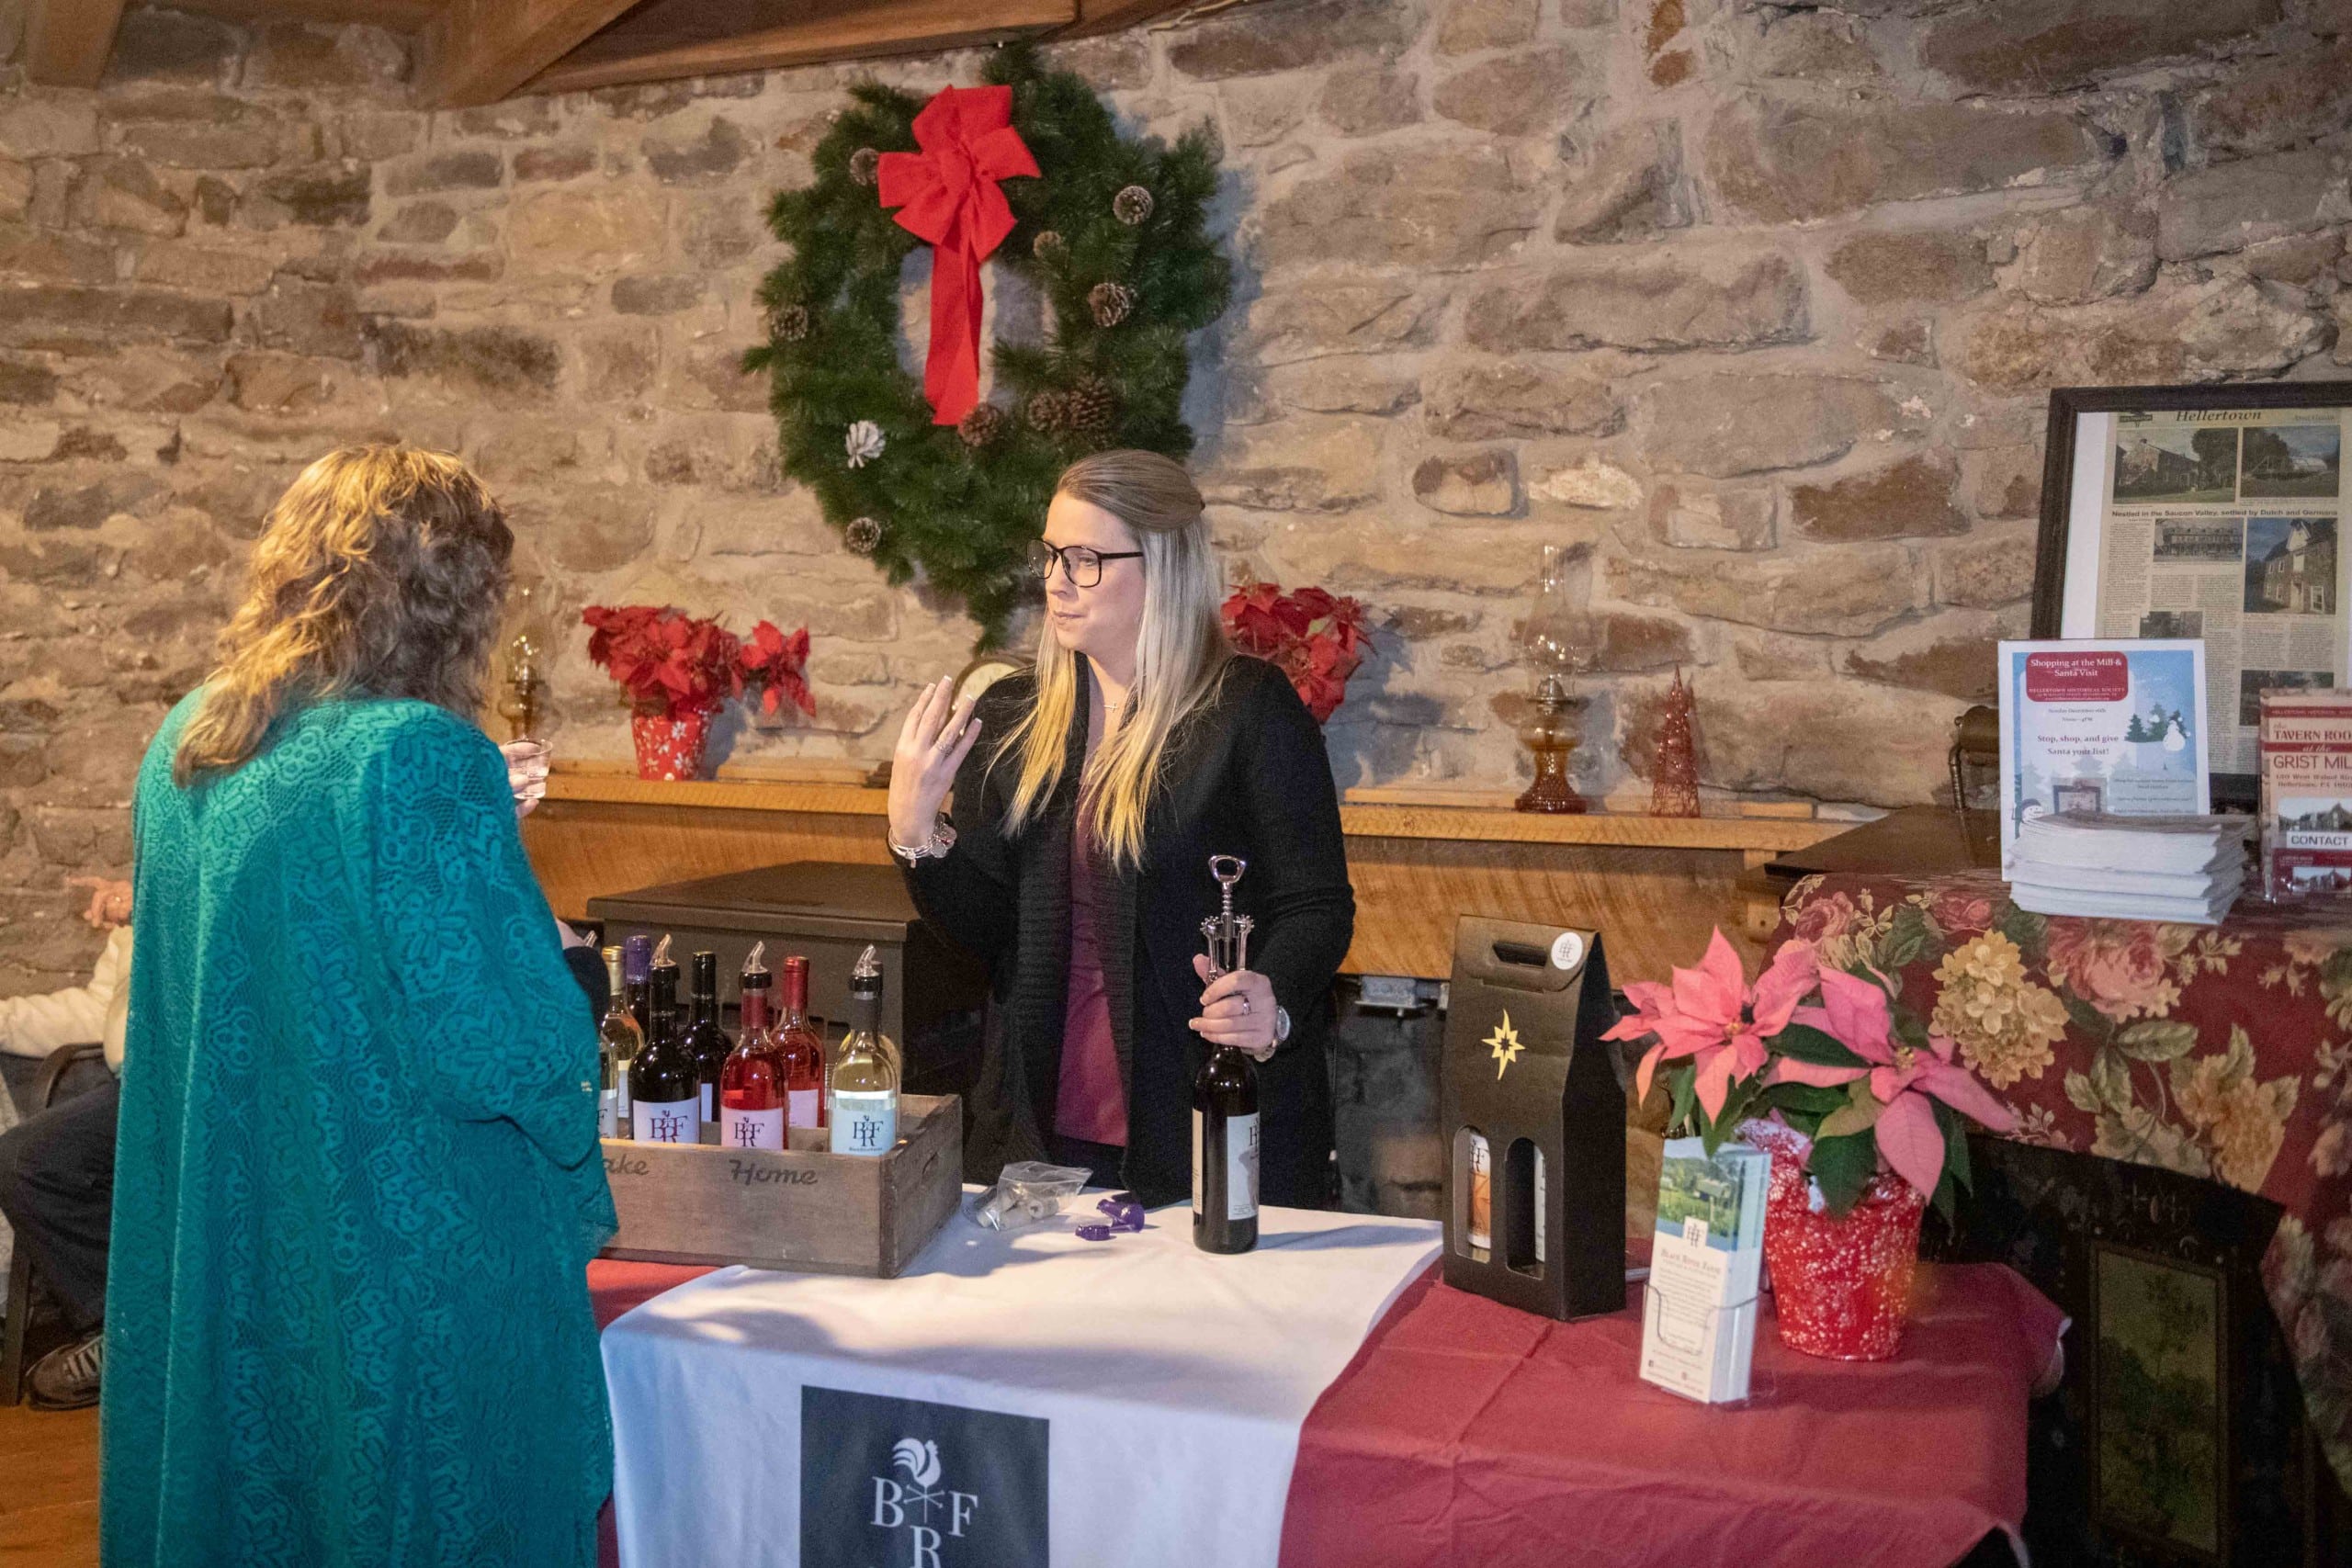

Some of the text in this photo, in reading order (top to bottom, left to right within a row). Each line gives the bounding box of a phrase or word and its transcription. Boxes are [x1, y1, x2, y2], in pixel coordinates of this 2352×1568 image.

[2176, 410, 2262, 422] Hellertown
[2111, 510, 2140, 518] Nestled
[2195, 509, 2218, 517] Valley,
[2030, 659, 2070, 668] Shopping
[2097, 658, 2114, 666] Mill
[2037, 734, 2058, 743] Stop,
[2060, 735, 2082, 743] shop,
[2274, 730, 2352, 740] TAVERN ROO
[2302, 743, 2332, 752] at the
[2273, 755, 2352, 770] GRIST MIL
[2291, 835, 2348, 846] CONTACT
[603, 1153, 818, 1186] ake Home
